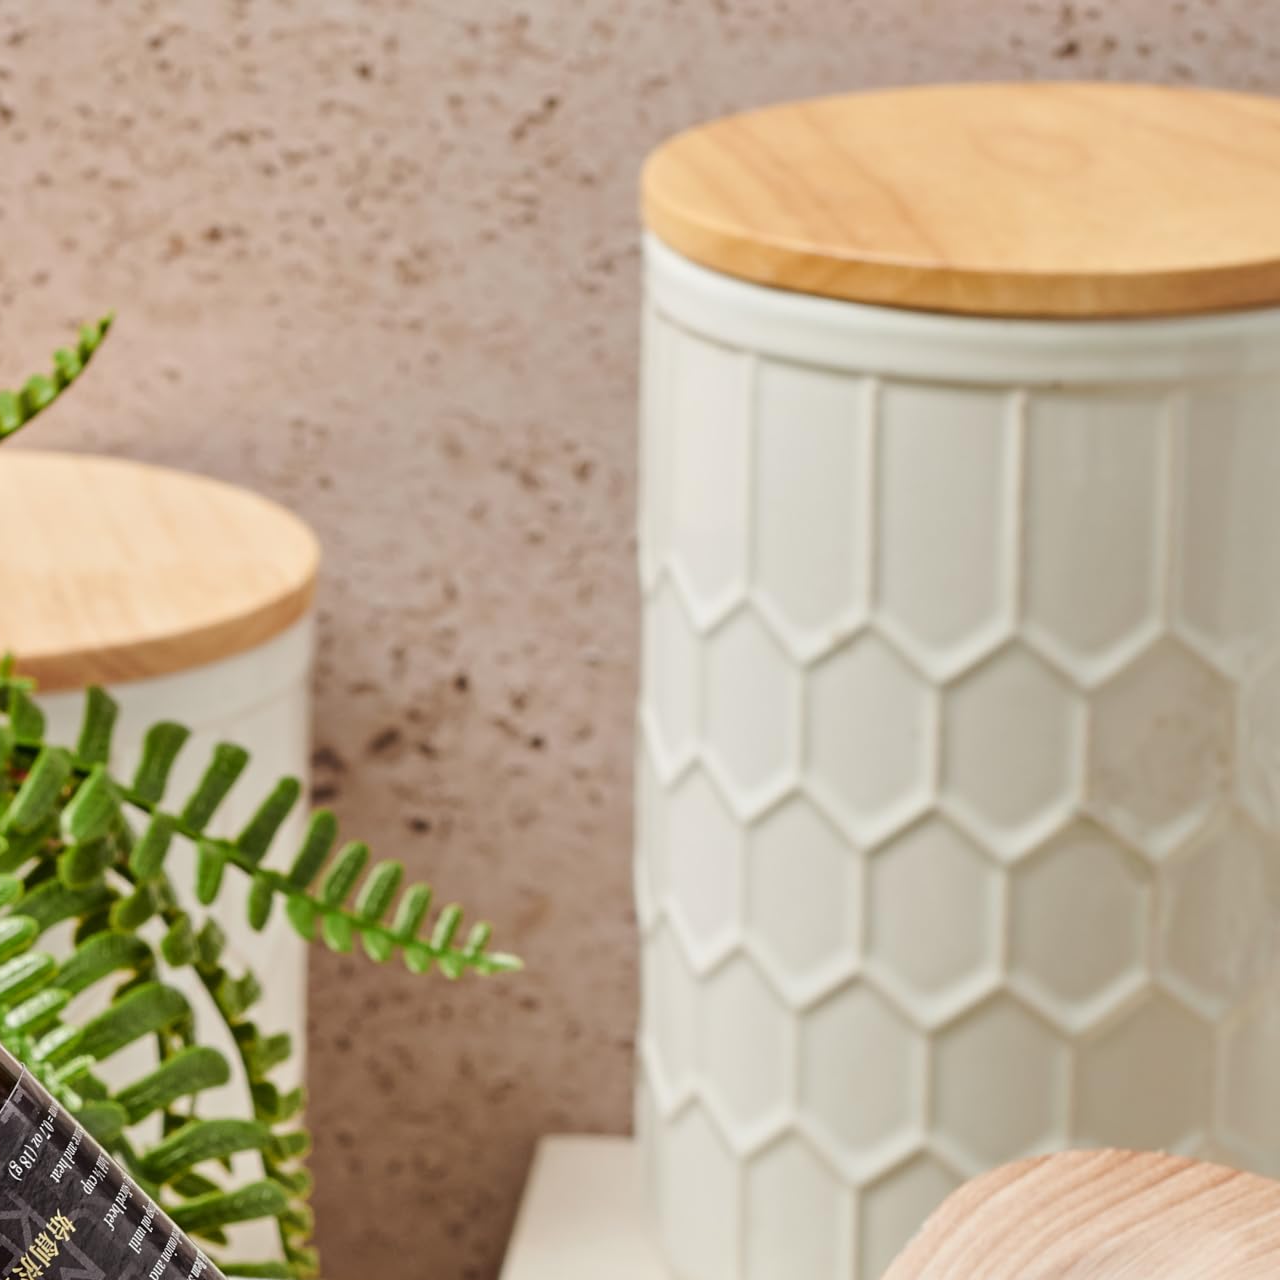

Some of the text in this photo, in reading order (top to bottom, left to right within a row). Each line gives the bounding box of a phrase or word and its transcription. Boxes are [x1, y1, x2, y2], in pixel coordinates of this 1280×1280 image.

[28, 1131, 44, 1149] oz
[36, 1118, 56, 1140] 0.7
[16, 1142, 39, 1170] (18
[62, 1139, 79, 1165] and
[3, 1158, 27, 1183] g)
[47, 1156, 72, 1185] heat
[79, 1173, 99, 1196] cup
[113, 1181, 133, 1211] sliced
[101, 1201, 125, 1232] beef
[139, 1213, 156, 1234] oil
[126, 1224, 149, 1255] until
[159, 1235, 183, 1265] onion
